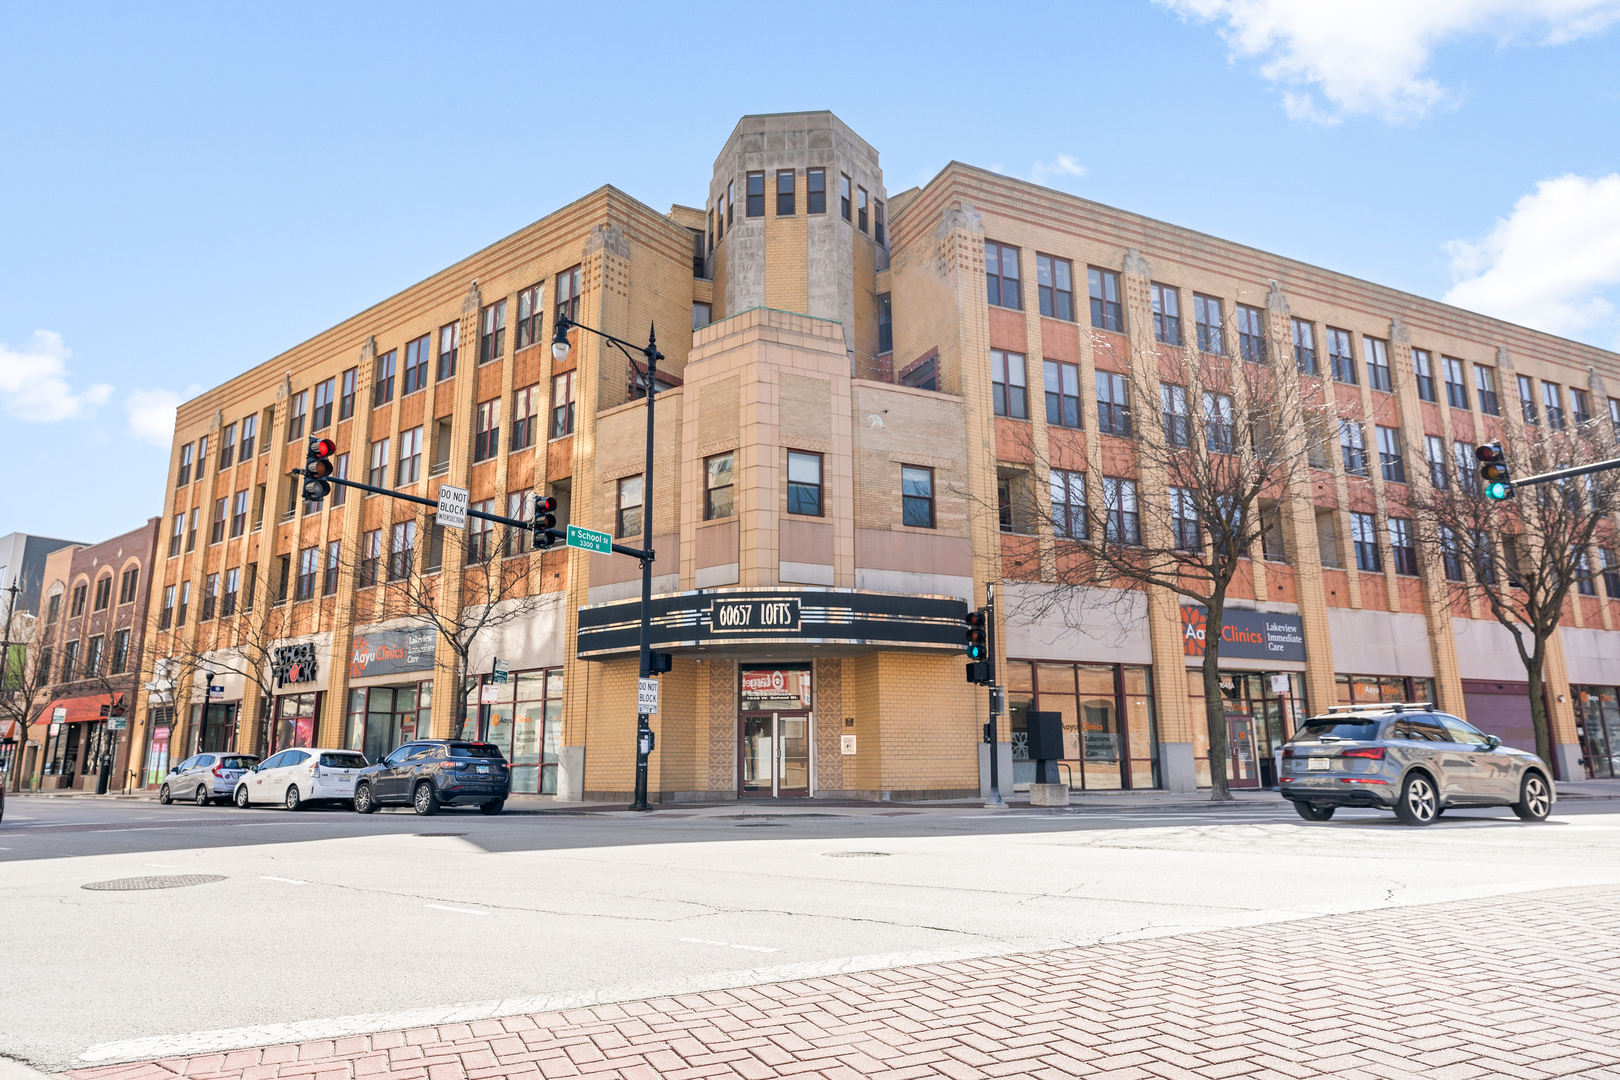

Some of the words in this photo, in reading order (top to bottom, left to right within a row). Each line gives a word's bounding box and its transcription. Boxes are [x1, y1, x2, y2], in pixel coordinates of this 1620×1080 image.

[441, 489, 451, 499] DO
[453, 492, 467, 503] NOT
[440, 502, 465, 515] BLOCK
[439, 513, 464, 524] INTERSECTION
[577, 530, 602, 543] School
[580, 540, 594, 548] 3300
[720, 604, 752, 626] 60657
[761, 603, 791, 625] LOFTS
[1266, 623, 1297, 633] Lakeview
[408, 634, 433, 645] Lakeview
[1222, 625, 1263, 644] Clinics
[1267, 633, 1302, 643] Immediate
[1268, 642, 1284, 651] Care
[273, 642, 315, 666] SCHOOL
[353, 649, 375, 667] Aayu
[375, 644, 404, 661] Clinics
[407, 655, 419, 663] Care
[282, 662, 315, 683] ROCK
[639, 682, 646, 690] DO
[648, 683, 657, 691] NOT
[640, 693, 657, 702] BLOCK
[1082, 721, 1103, 730] Clinics
